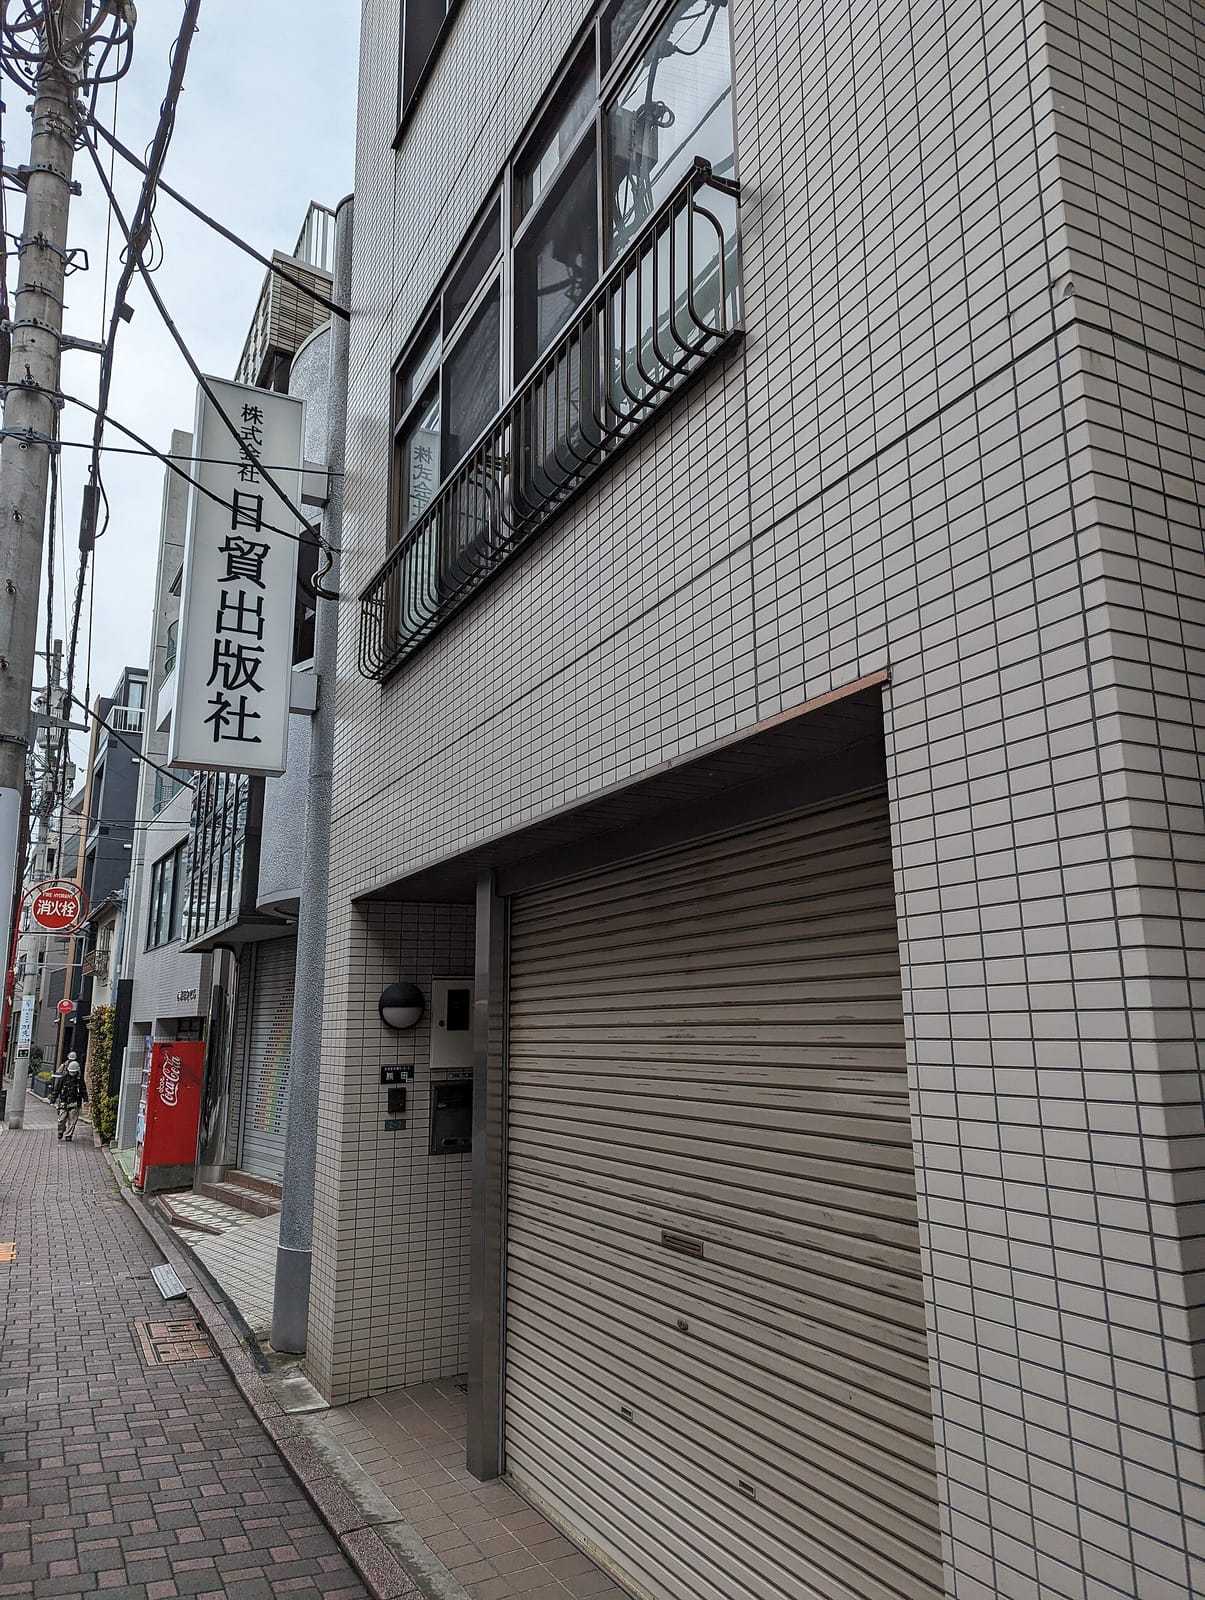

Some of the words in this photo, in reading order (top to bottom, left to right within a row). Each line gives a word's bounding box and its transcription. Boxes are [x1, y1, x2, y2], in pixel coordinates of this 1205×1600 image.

[237, 404, 264, 484] 株式会社
[203, 488, 271, 744] 日貿出版社
[36, 899, 76, 918] 消火栓
